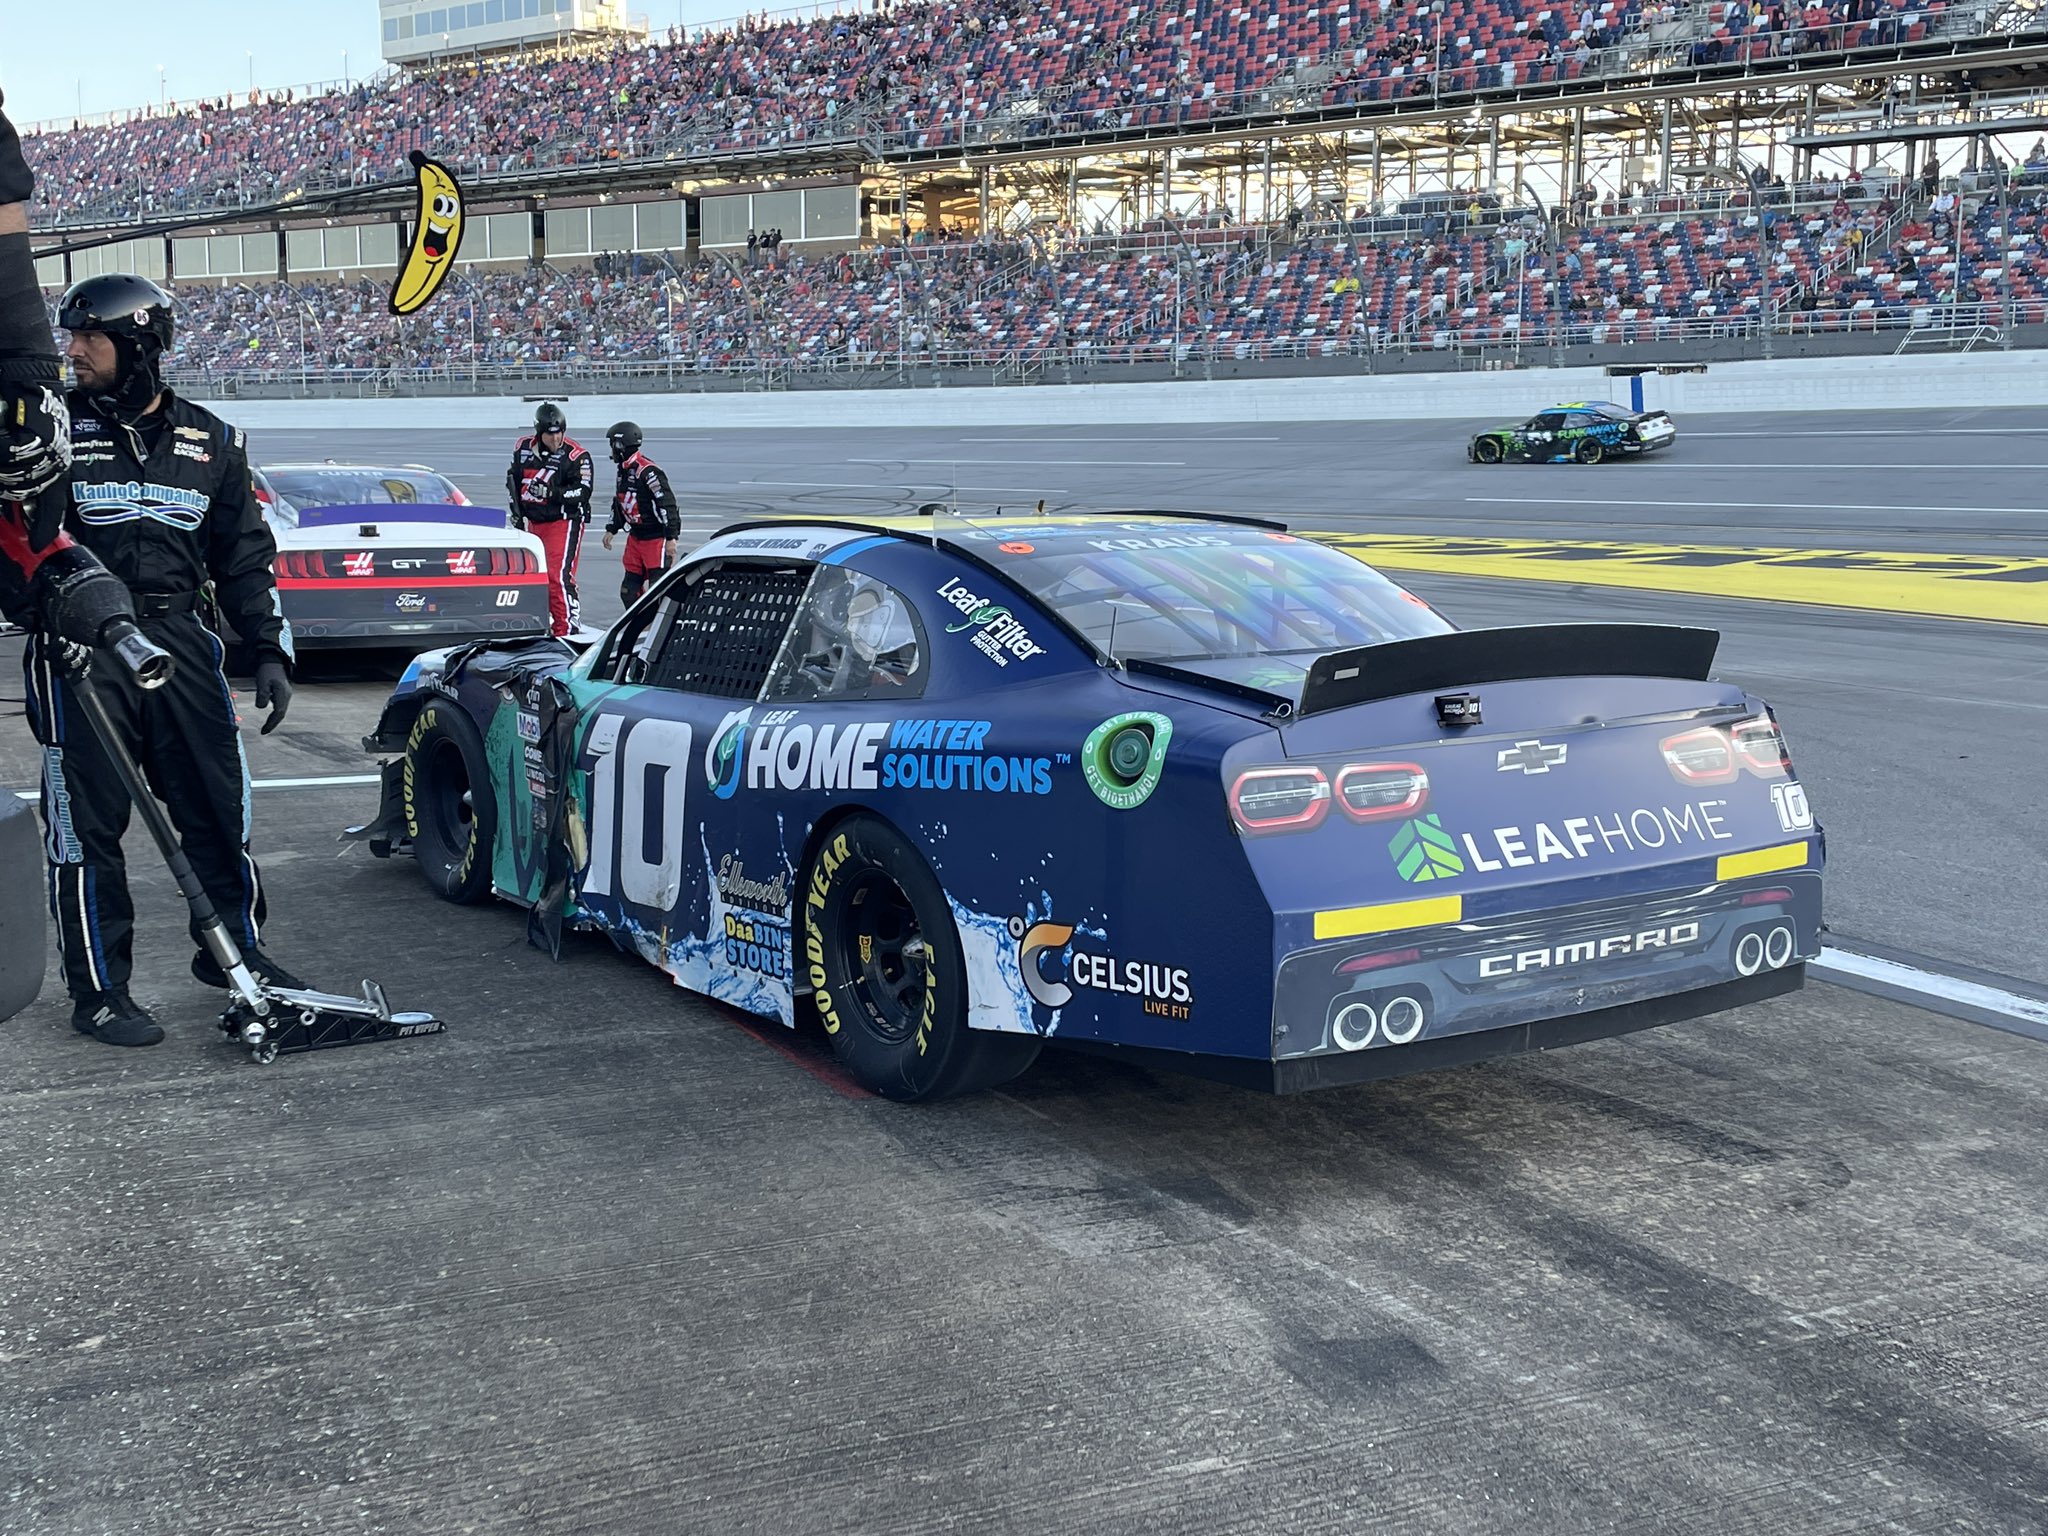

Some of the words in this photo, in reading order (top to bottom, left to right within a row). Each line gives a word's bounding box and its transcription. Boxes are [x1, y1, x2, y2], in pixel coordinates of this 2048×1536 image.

[71, 439, 114, 449] OODYEAR
[1087, 535, 1231, 552] KRAUS
[391, 559, 427, 569] GT
[395, 592, 426, 607] Ford
[495, 590, 519, 607] 00
[937, 576, 990, 615] Leaf
[984, 614, 1044, 661] Filter
[970, 634, 1009, 668] PROTECTION
[977, 630, 1002, 652] GUTTER
[518, 711, 541, 738] Mobi
[760, 709, 799, 726] LEAF
[1098, 717, 1119, 734] GET
[890, 719, 992, 750] WATER
[524, 745, 543, 763] COME
[748, 721, 891, 790] HOME
[526, 767, 546, 783] LINCOL
[882, 753, 1053, 795] SOLUTIONS
[1085, 764, 1102, 789] GET
[1100, 773, 1156, 806] BIOETHANOL
[582, 712, 694, 913] 10
[1770, 781, 1814, 832] 10
[717, 853, 788, 907] Ellsworth
[725, 915, 783, 950] DaaBIN
[805, 833, 852, 1035] GOODYEAR
[727, 938, 784, 977] STORE
[1479, 922, 1700, 978] CAMARO
[1144, 1000, 1169, 1016] LIVE
[1171, 1005, 1190, 1019] FIT
